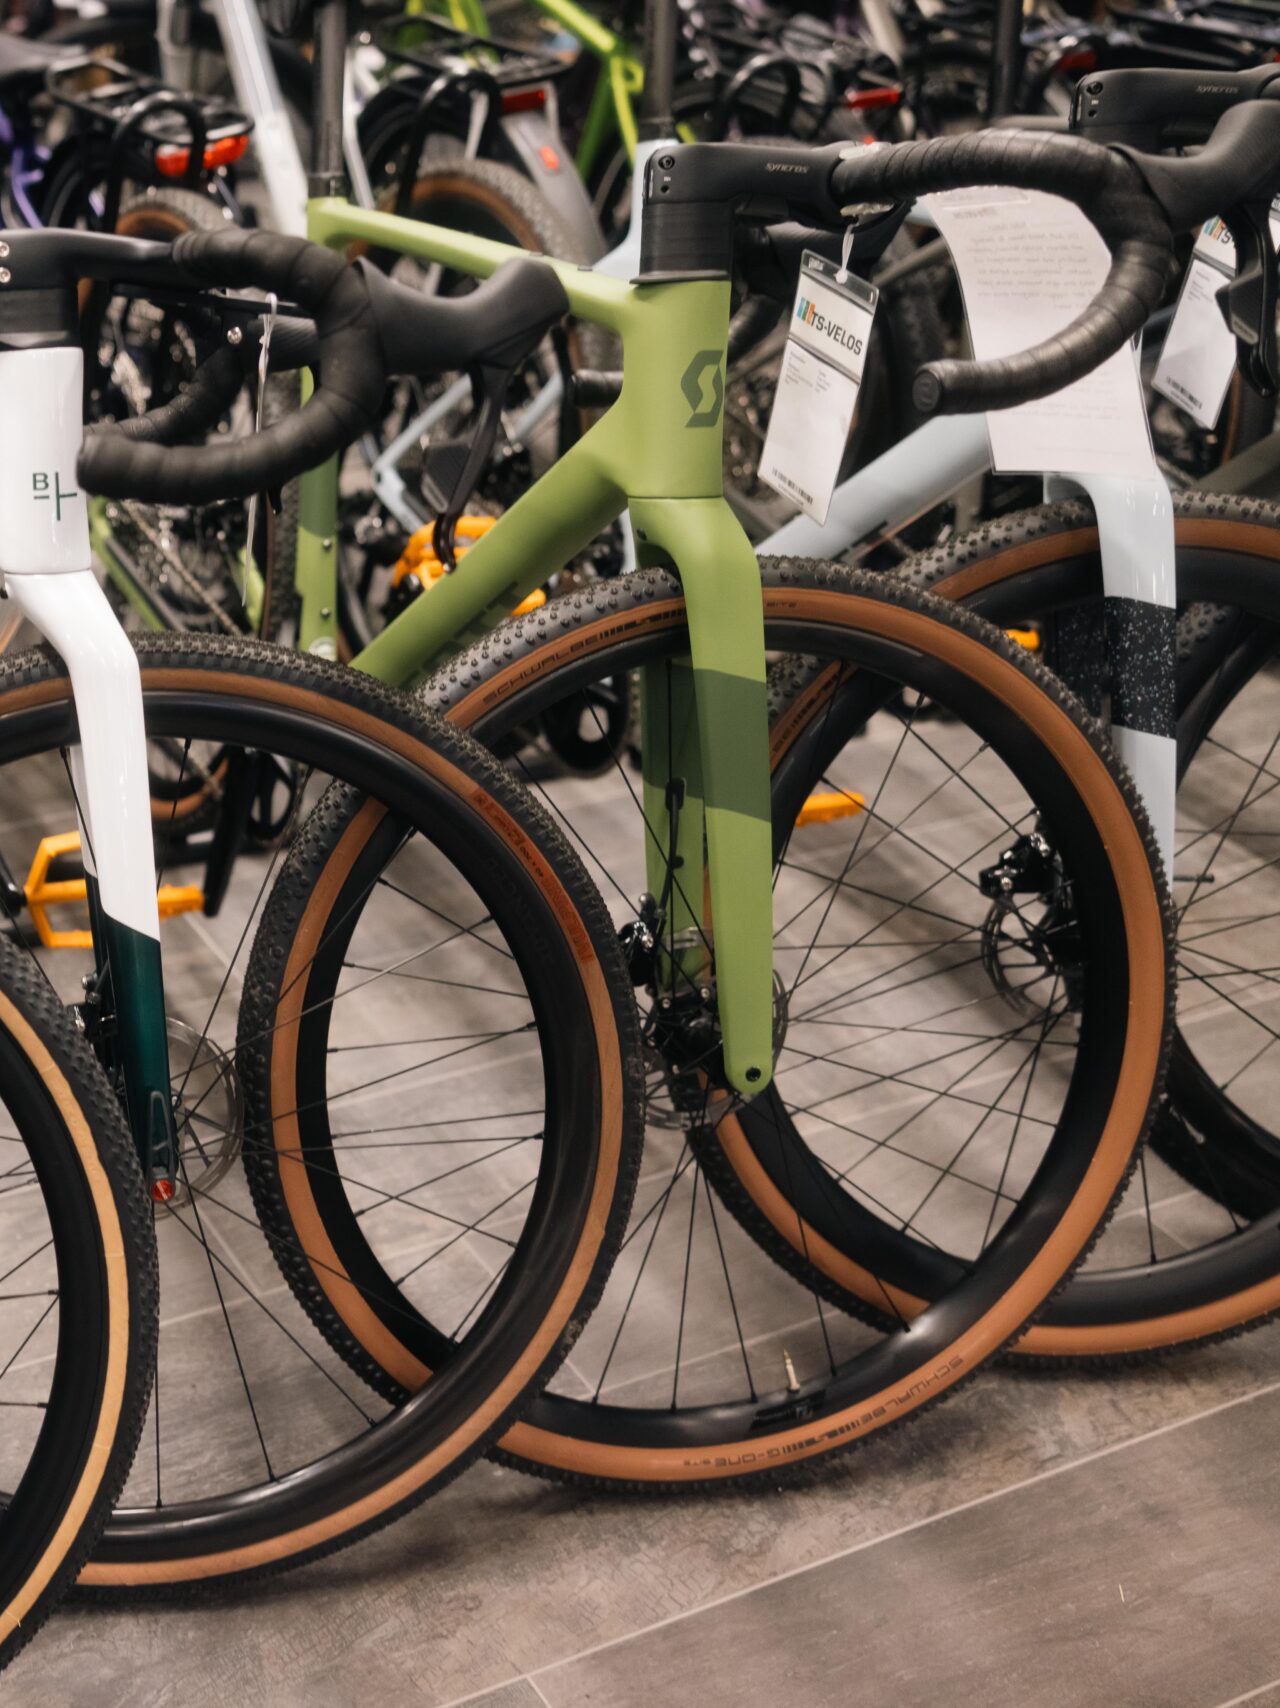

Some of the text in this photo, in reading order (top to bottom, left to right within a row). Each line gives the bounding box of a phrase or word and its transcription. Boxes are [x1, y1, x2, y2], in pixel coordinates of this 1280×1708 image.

[811, 310, 863, 356] TS-VELOS
[481, 634, 600, 704] SCHWALBE
[859, 1355, 964, 1424] SCHWALBE
